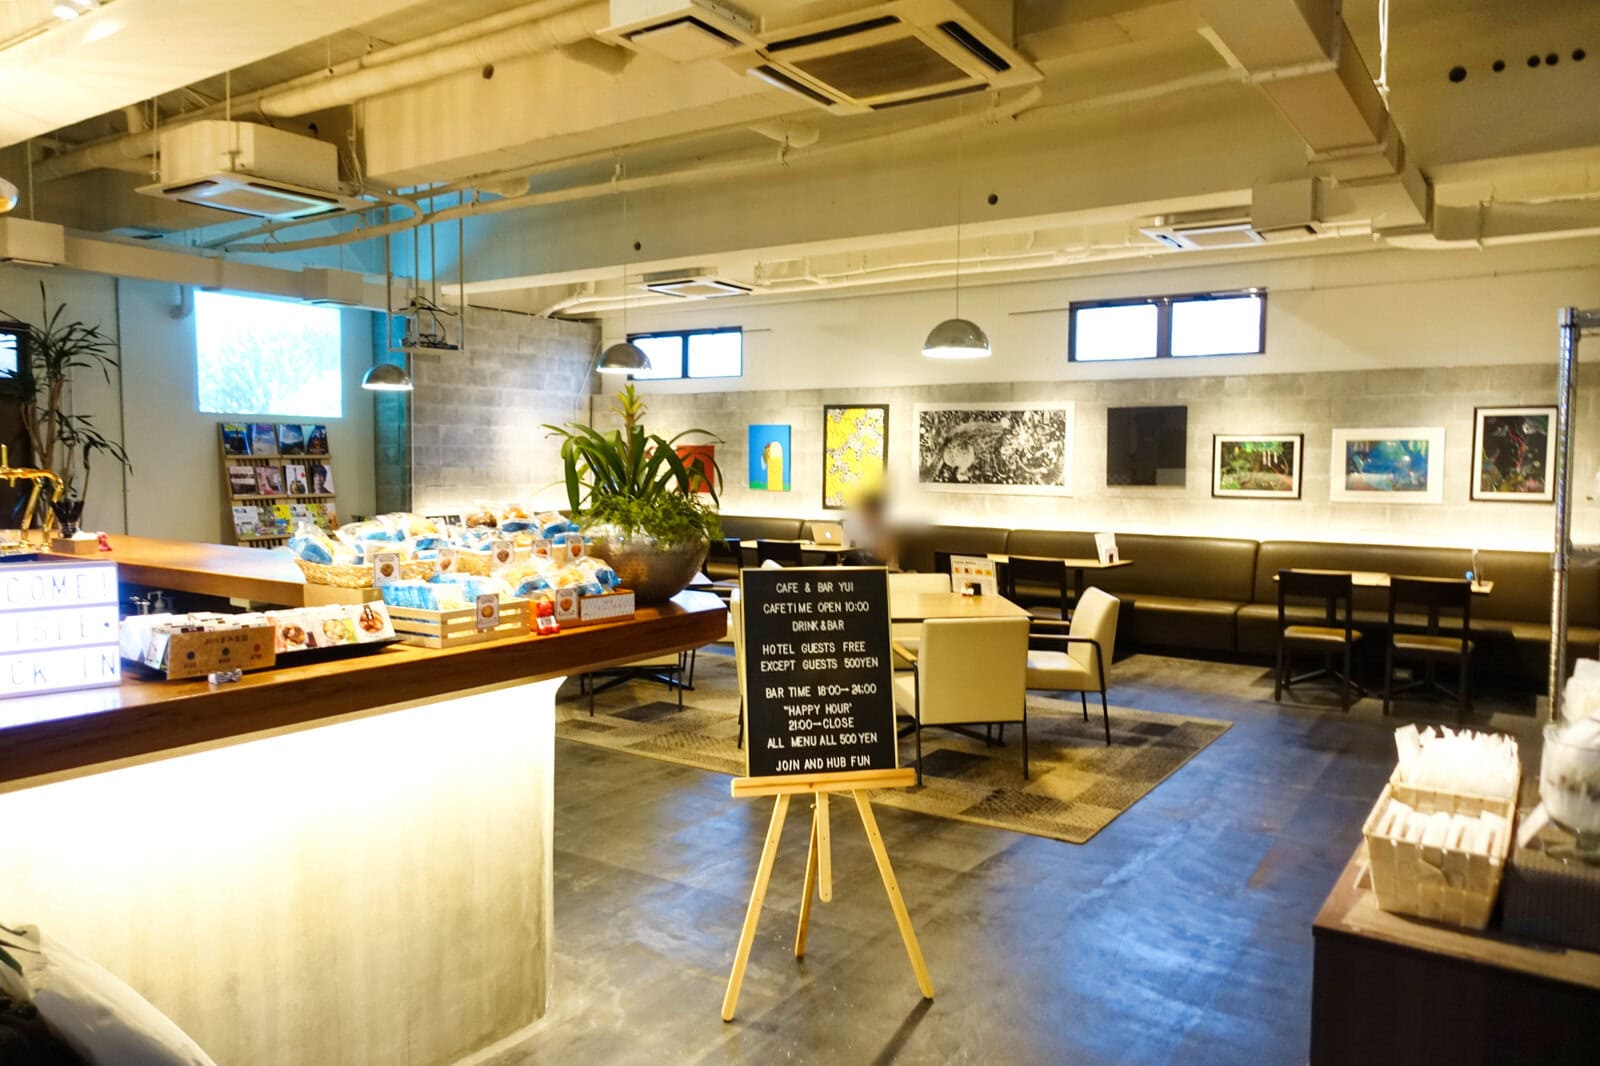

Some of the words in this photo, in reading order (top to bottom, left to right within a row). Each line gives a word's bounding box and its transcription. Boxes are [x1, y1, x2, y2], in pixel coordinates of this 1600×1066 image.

[776, 583, 798, 594] CAFE
[804, 583, 811, 593] &
[818, 582, 833, 592] BAR
[838, 582, 854, 592] YUI
[763, 602, 812, 614] CAFETIME
[818, 602, 842, 612] OPEN
[845, 601, 869, 612] 10:00
[762, 644, 795, 654] HOTEL
[801, 642, 835, 654] GUESTS
[843, 642, 866, 652] FREE
[761, 660, 796, 672] EXCEPT
[802, 658, 838, 670] GUESTS
[766, 688, 784, 698] BAR
[788, 686, 811, 698] TIME
[767, 738, 784, 749] ALL
[791, 736, 816, 748] MENU
[820, 735, 837, 746] ALL
[776, 760, 800, 772] JOIN
[804, 758, 823, 770] AND
[827, 757, 846, 768] HUB
[851, 756, 870, 766] FUN
